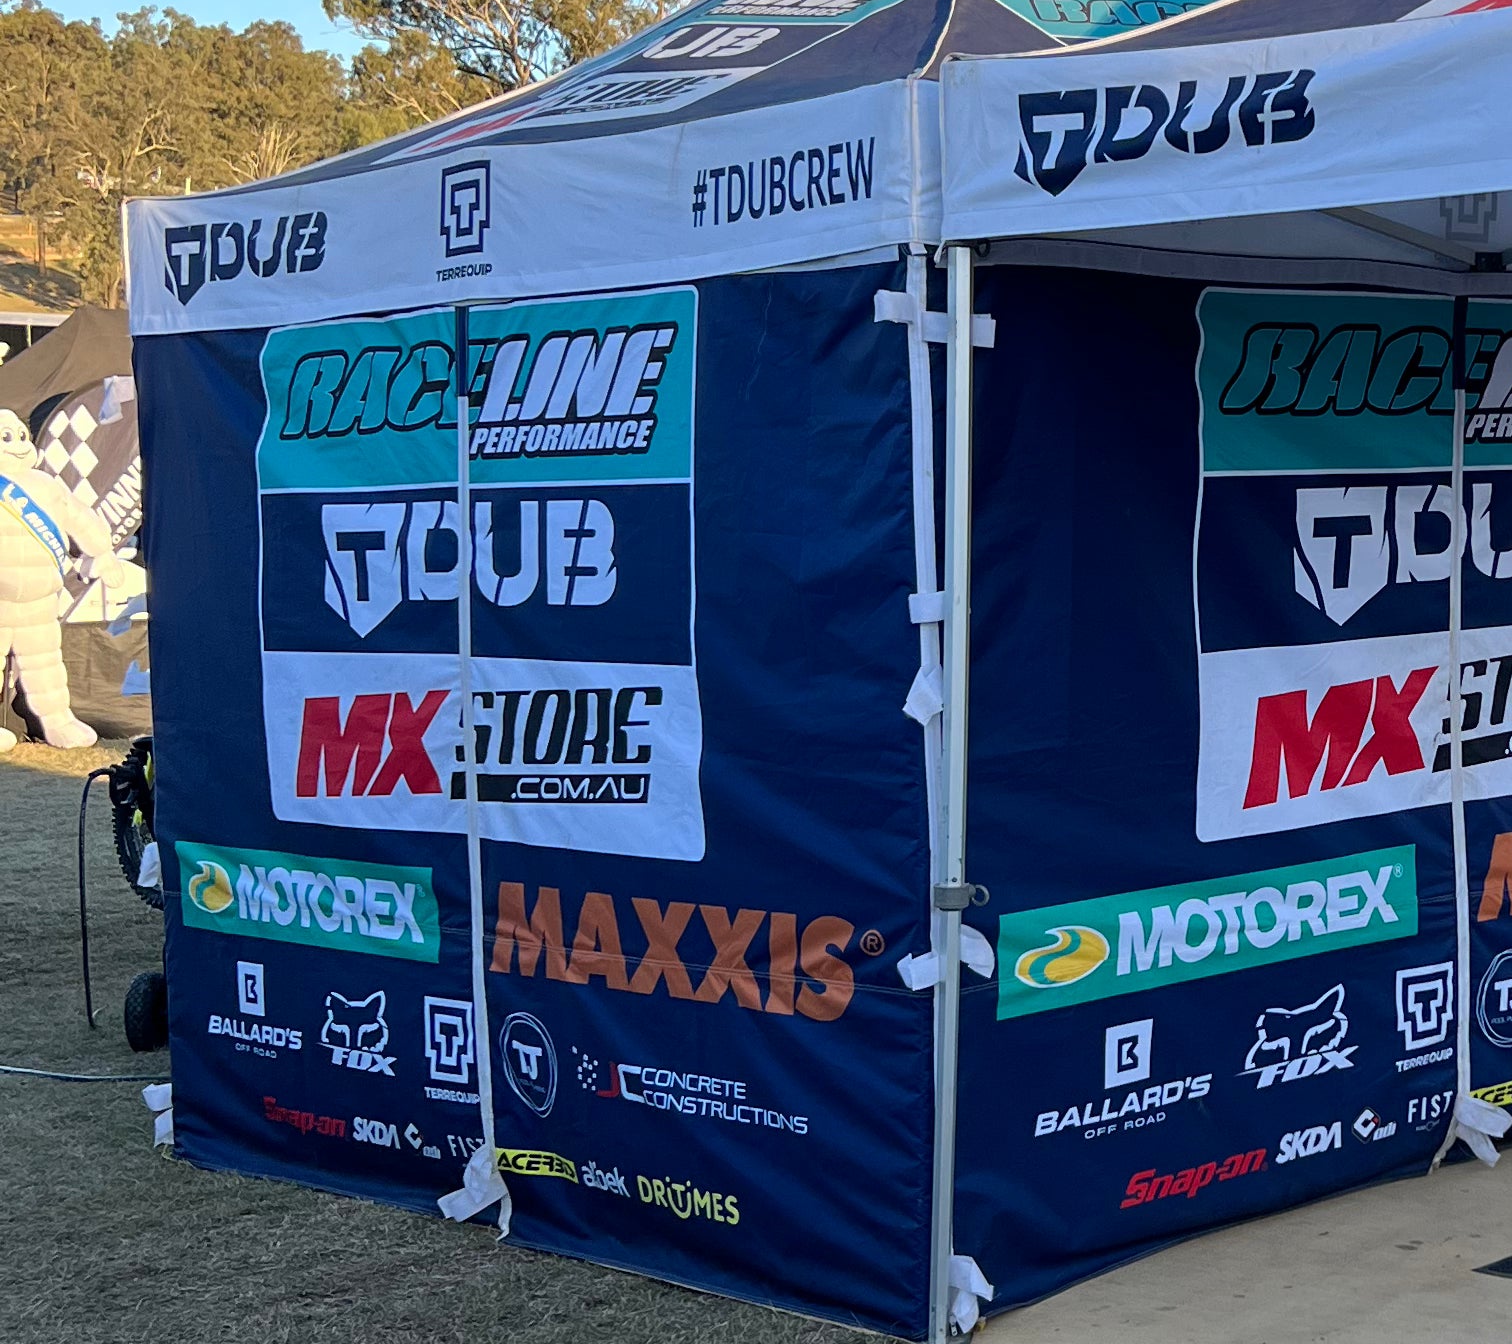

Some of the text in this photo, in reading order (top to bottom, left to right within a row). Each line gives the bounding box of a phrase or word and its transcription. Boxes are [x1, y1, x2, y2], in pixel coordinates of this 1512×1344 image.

[1013, 69, 1316, 197] TDUB
[692, 137, 875, 227] #TDUBCREW
[164, 211, 327, 305] TDUB
[436, 263, 492, 282] TERREQUIP
[469, 419, 655, 458] PERFORMANCE
[323, 499, 617, 639] TDUB
[237, 865, 424, 944] MOTOREX
[1117, 864, 1399, 977] MOTOREX
[208, 1015, 303, 1050] BALLARD'S
[326, 1044, 398, 1077] FOX
[1242, 1045, 1359, 1090] FOX
[1396, 1047, 1453, 1073] TERREQUIP
[424, 1086, 481, 1105] TERREQUIP
[641, 1067, 747, 1100] CONCRETE
[1034, 1073, 1213, 1138] BALLARD'S
[642, 1090, 808, 1135] CONSTRUCTIONS
[1084, 1111, 1166, 1140] OFF ROAD
[1407, 1091, 1455, 1124] FIST
[1120, 1147, 1267, 1210] Snap-on
